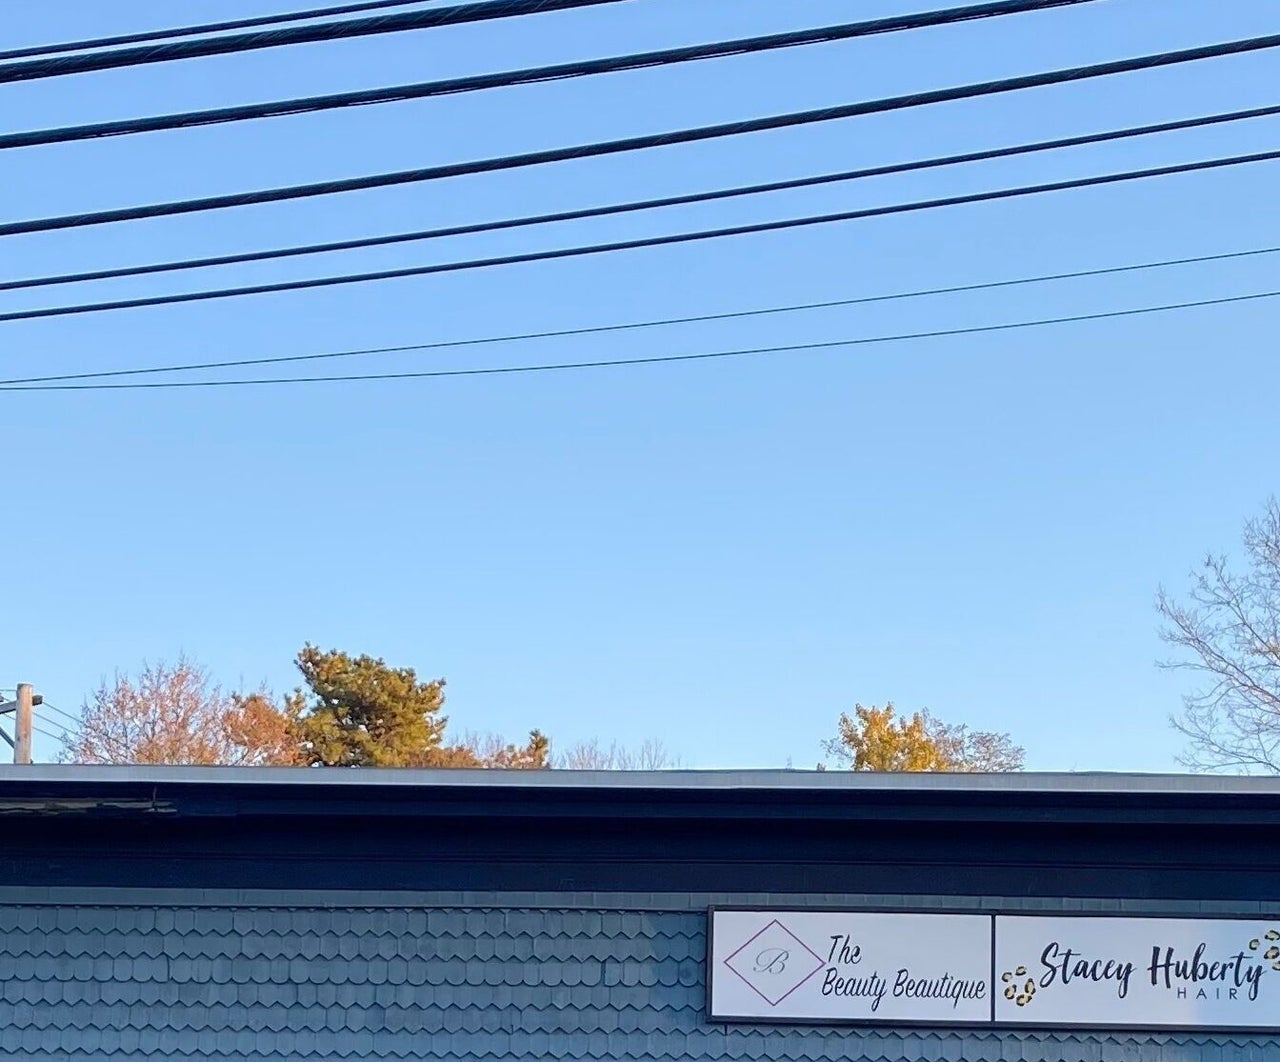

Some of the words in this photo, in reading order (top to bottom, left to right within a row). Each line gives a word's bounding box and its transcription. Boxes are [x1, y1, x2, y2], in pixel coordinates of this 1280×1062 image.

[828, 934, 862, 965] The
[821, 967, 888, 1012] Beauty
[892, 968, 987, 1009] Beautique
[1039, 942, 1137, 999] Stacey
[1147, 942, 1268, 1001] Huberty
[1176, 986, 1239, 1000] HAIR
